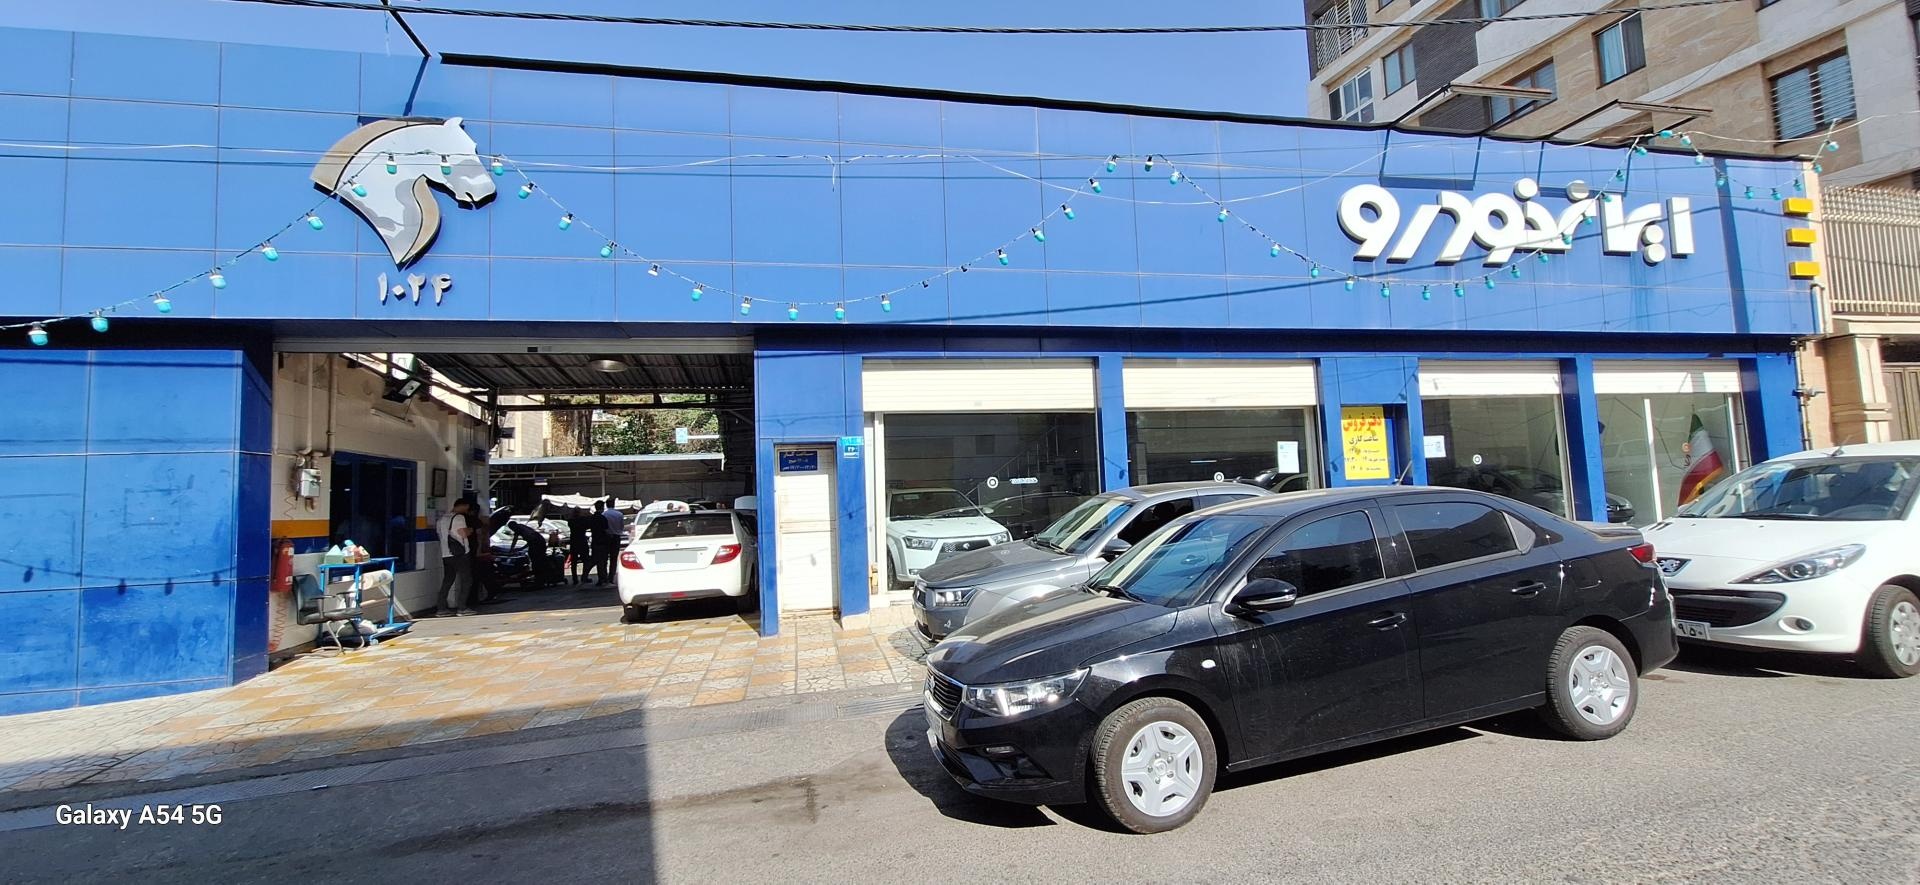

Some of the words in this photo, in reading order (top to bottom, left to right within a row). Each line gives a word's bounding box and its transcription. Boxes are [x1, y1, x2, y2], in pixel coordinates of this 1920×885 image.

[377, 271, 452, 306] ۱۰۲۴
[1343, 412, 1366, 432] فروش
[1366, 412, 1382, 431] دفتر
